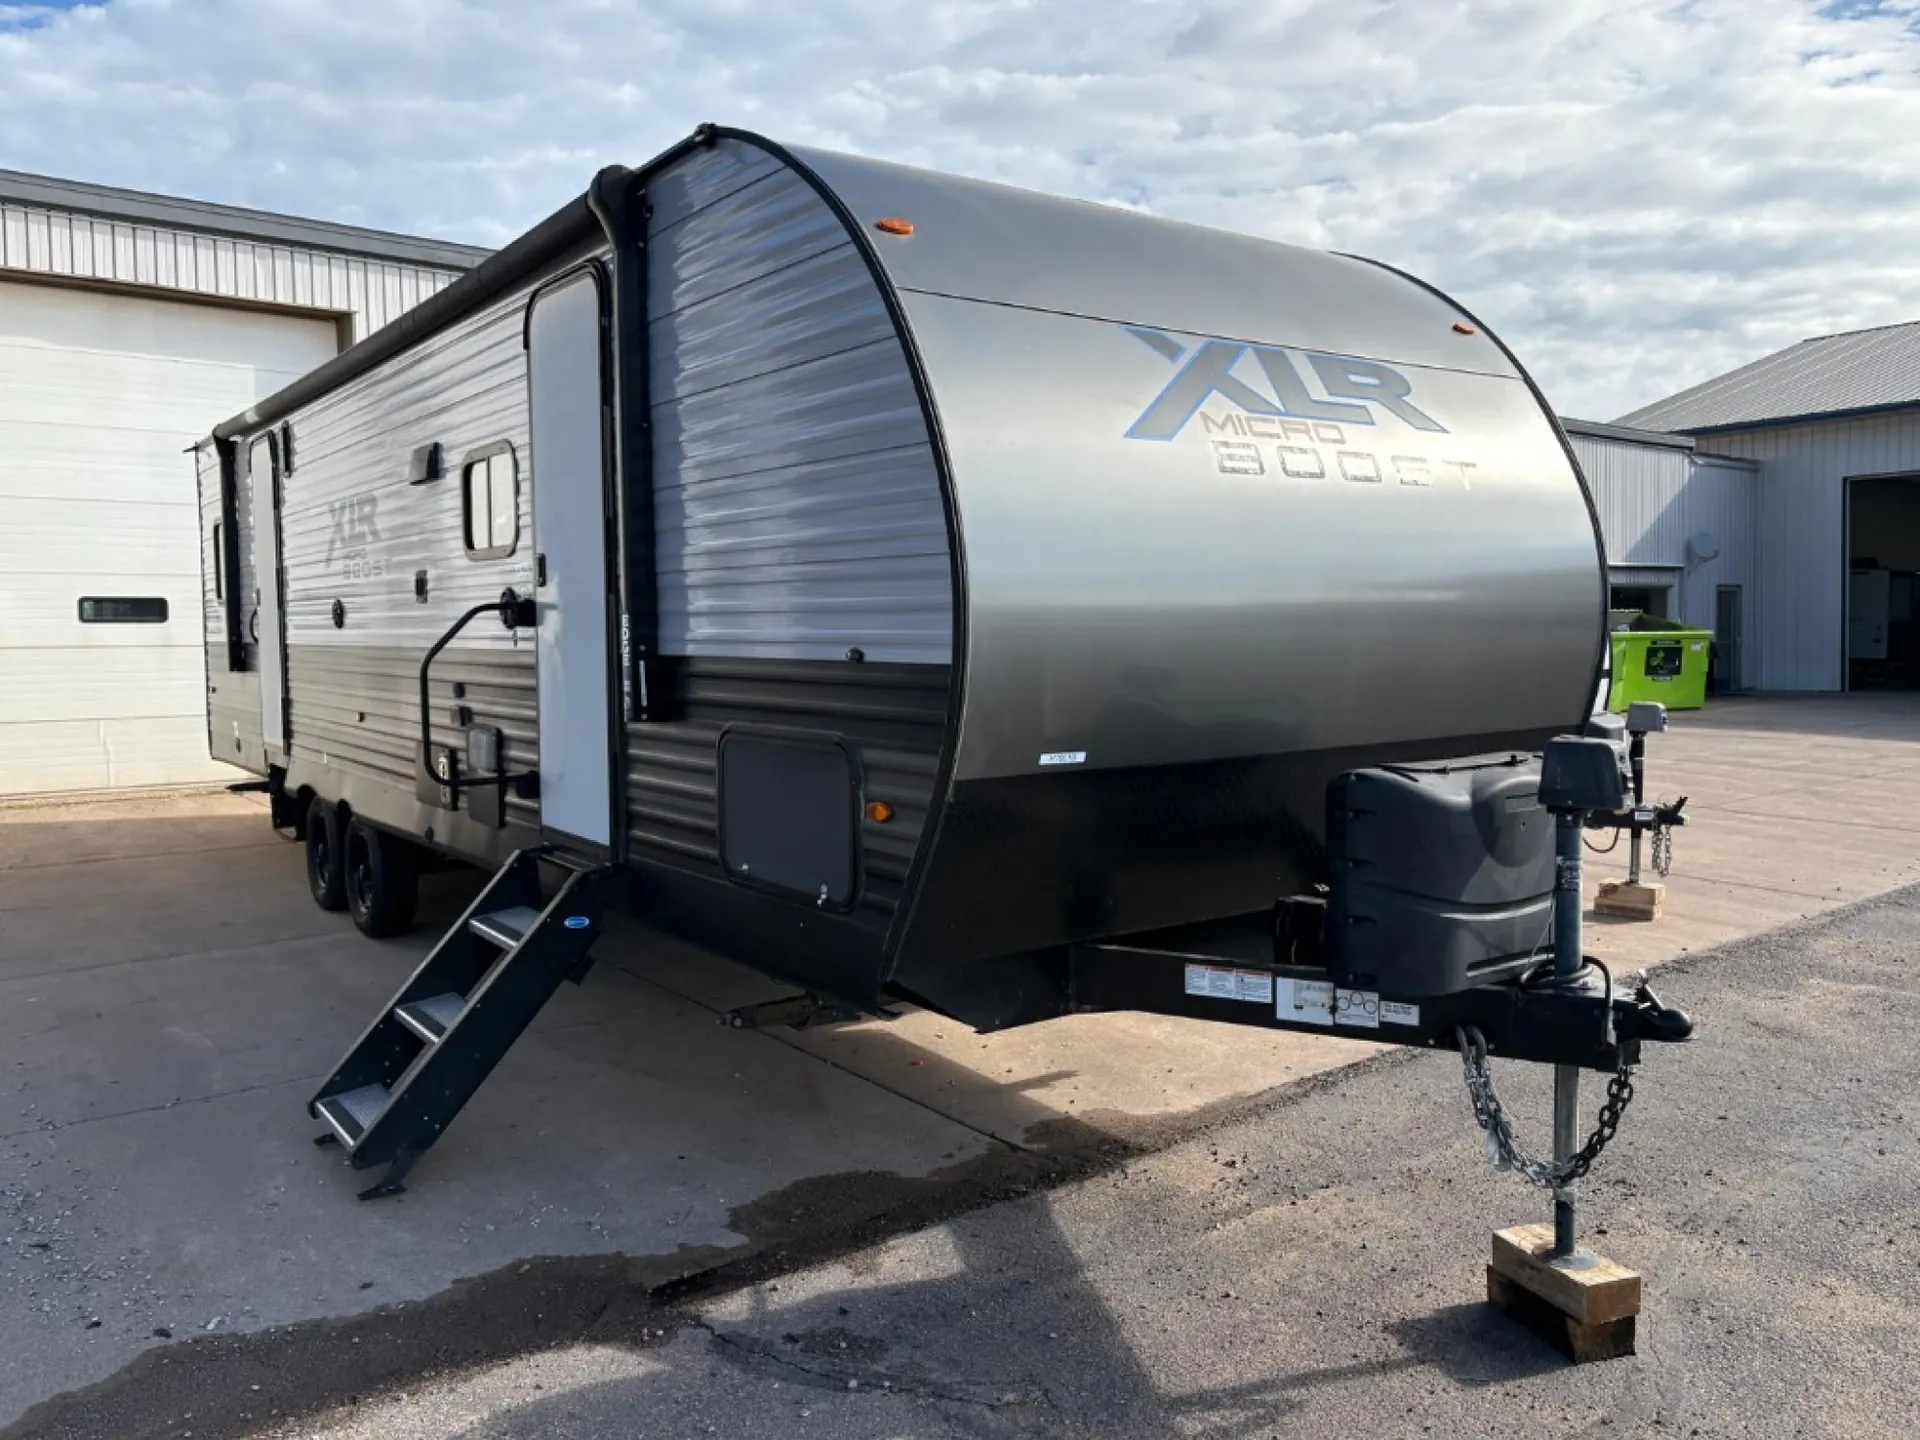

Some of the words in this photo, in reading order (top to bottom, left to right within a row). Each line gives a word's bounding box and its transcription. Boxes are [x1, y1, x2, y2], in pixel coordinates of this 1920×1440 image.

[1122, 325, 1450, 441] XLR
[1201, 411, 1347, 445] MICRO
[1211, 440, 1478, 491] BOOST
[323, 493, 382, 569] XLR
